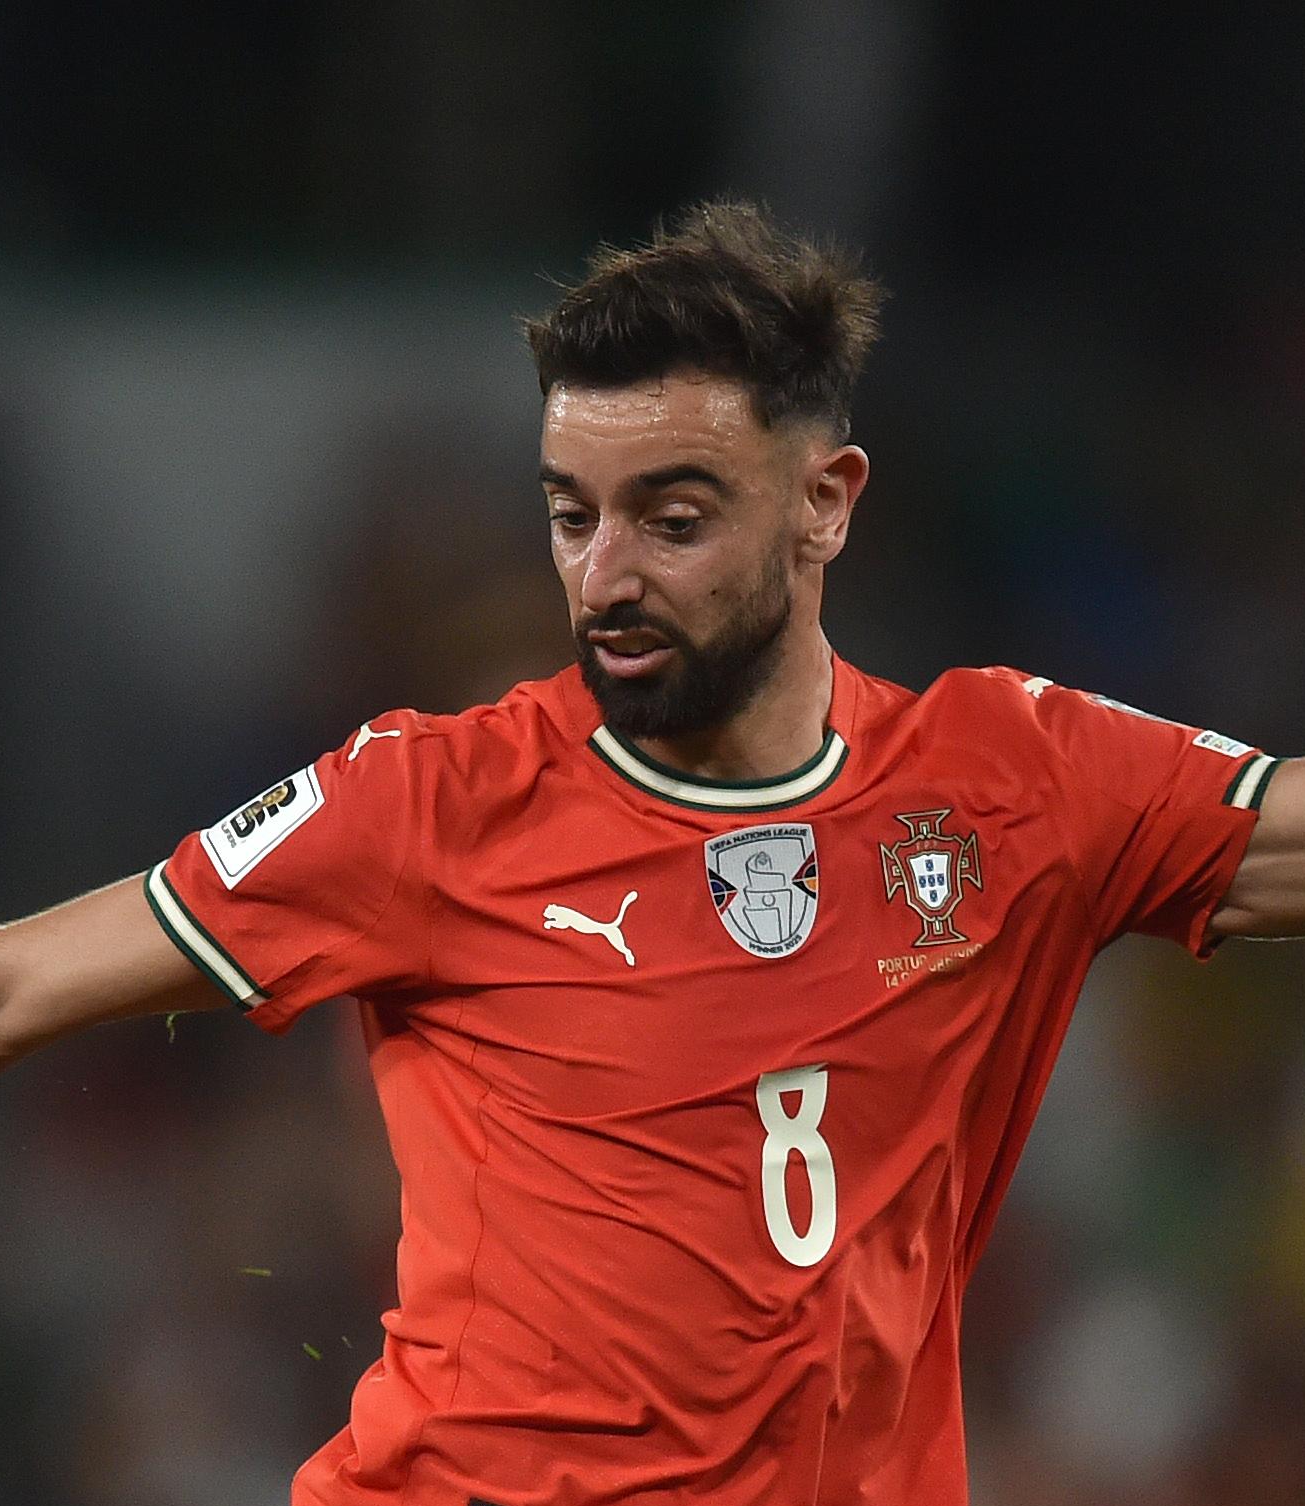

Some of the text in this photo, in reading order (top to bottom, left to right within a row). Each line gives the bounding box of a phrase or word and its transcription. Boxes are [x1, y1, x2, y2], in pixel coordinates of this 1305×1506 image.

[709, 828, 808, 851] UEFA NATIONS LEAGUE
[749, 934, 803, 953] WINNER 2025
[756, 1063, 837, 1267] 8
